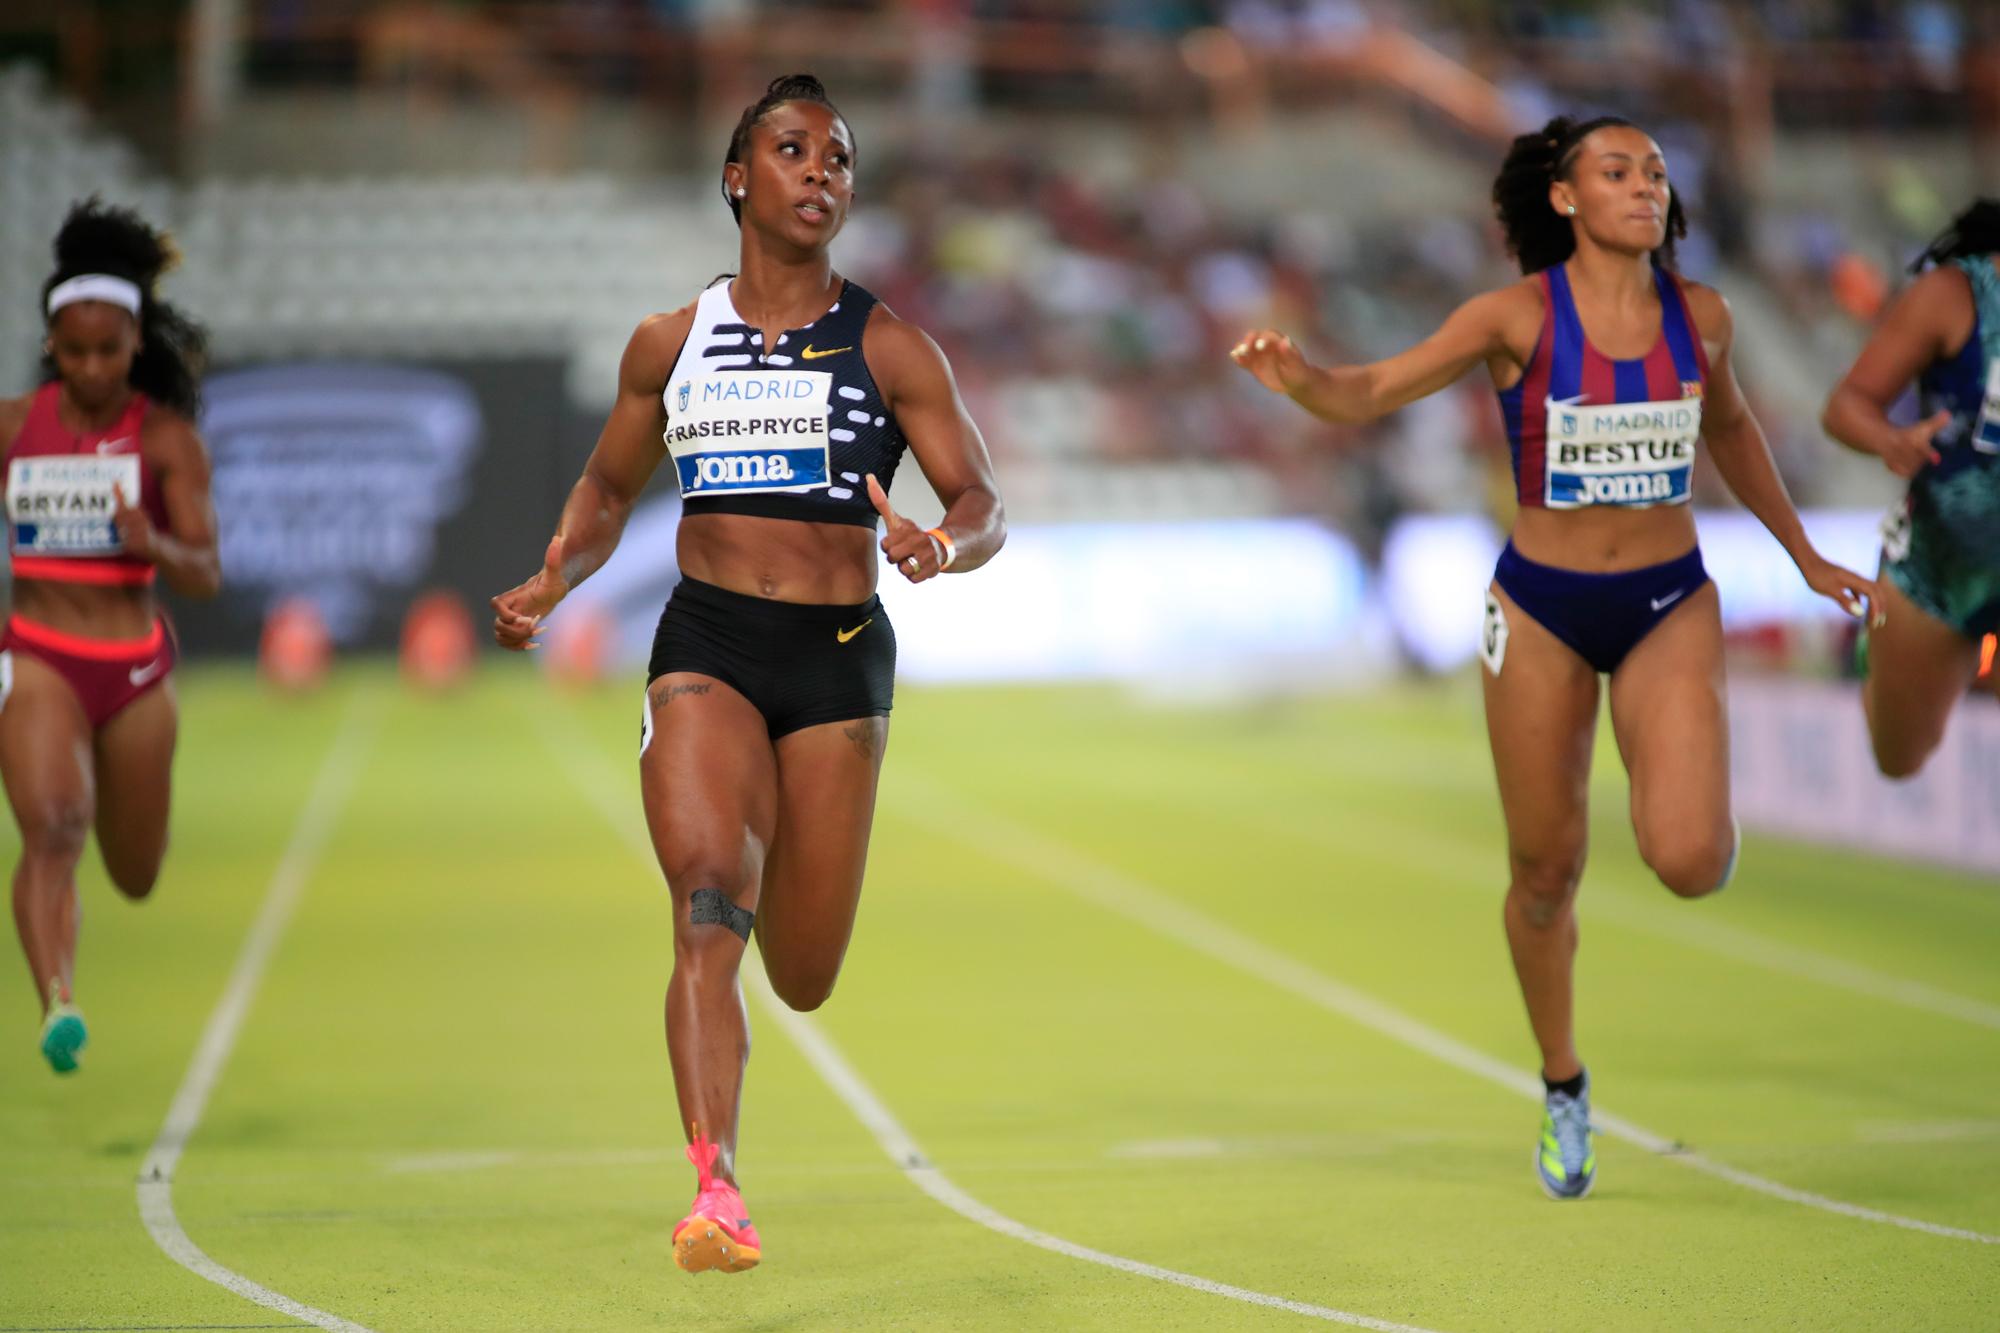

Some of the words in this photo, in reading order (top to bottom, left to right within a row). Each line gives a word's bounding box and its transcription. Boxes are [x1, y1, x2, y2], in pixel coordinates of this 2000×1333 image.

[703, 379, 815, 403] MADRID
[666, 417, 824, 444] FRASER-PRYCE
[1594, 408, 1693, 432] MADRID
